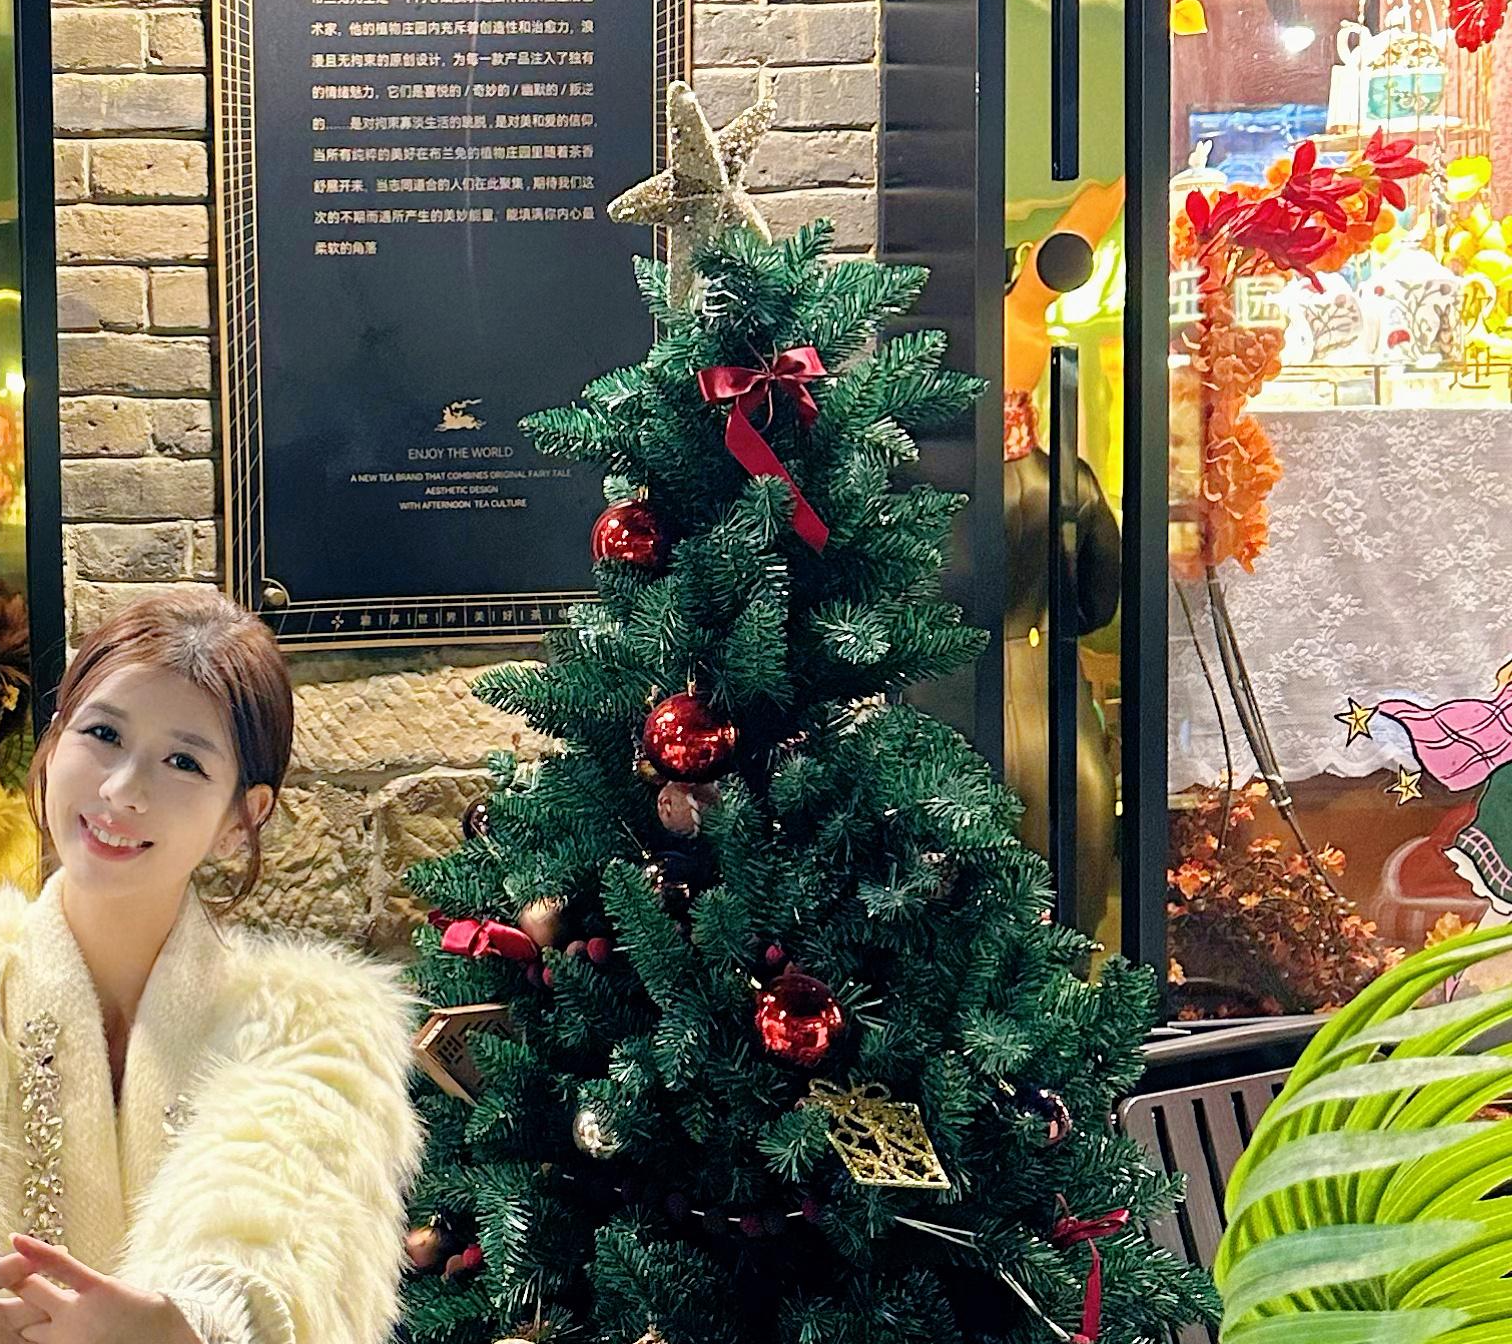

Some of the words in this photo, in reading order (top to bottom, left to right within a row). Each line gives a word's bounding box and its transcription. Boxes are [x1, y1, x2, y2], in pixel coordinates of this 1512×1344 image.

[408, 448, 444, 460] ENJOY
[447, 447, 468, 458] THE
[470, 446, 513, 458] WORLD
[358, 473, 378, 483] NEW
[379, 473, 394, 482] TEA
[395, 472, 424, 482] BRAND
[425, 471, 446, 481] THAT
[447, 471, 489, 481] COMBINES
[490, 470, 527, 480] ORIGINAL
[552, 468, 571, 478] TALE
[424, 486, 468, 496] AESTHETIC
[469, 485, 499, 495] DESIGN
[399, 501, 421, 511] WITH
[422, 500, 471, 510] AFTERNOON
[474, 499, 489, 509] TEA
[491, 498, 527, 508] CULTURE
